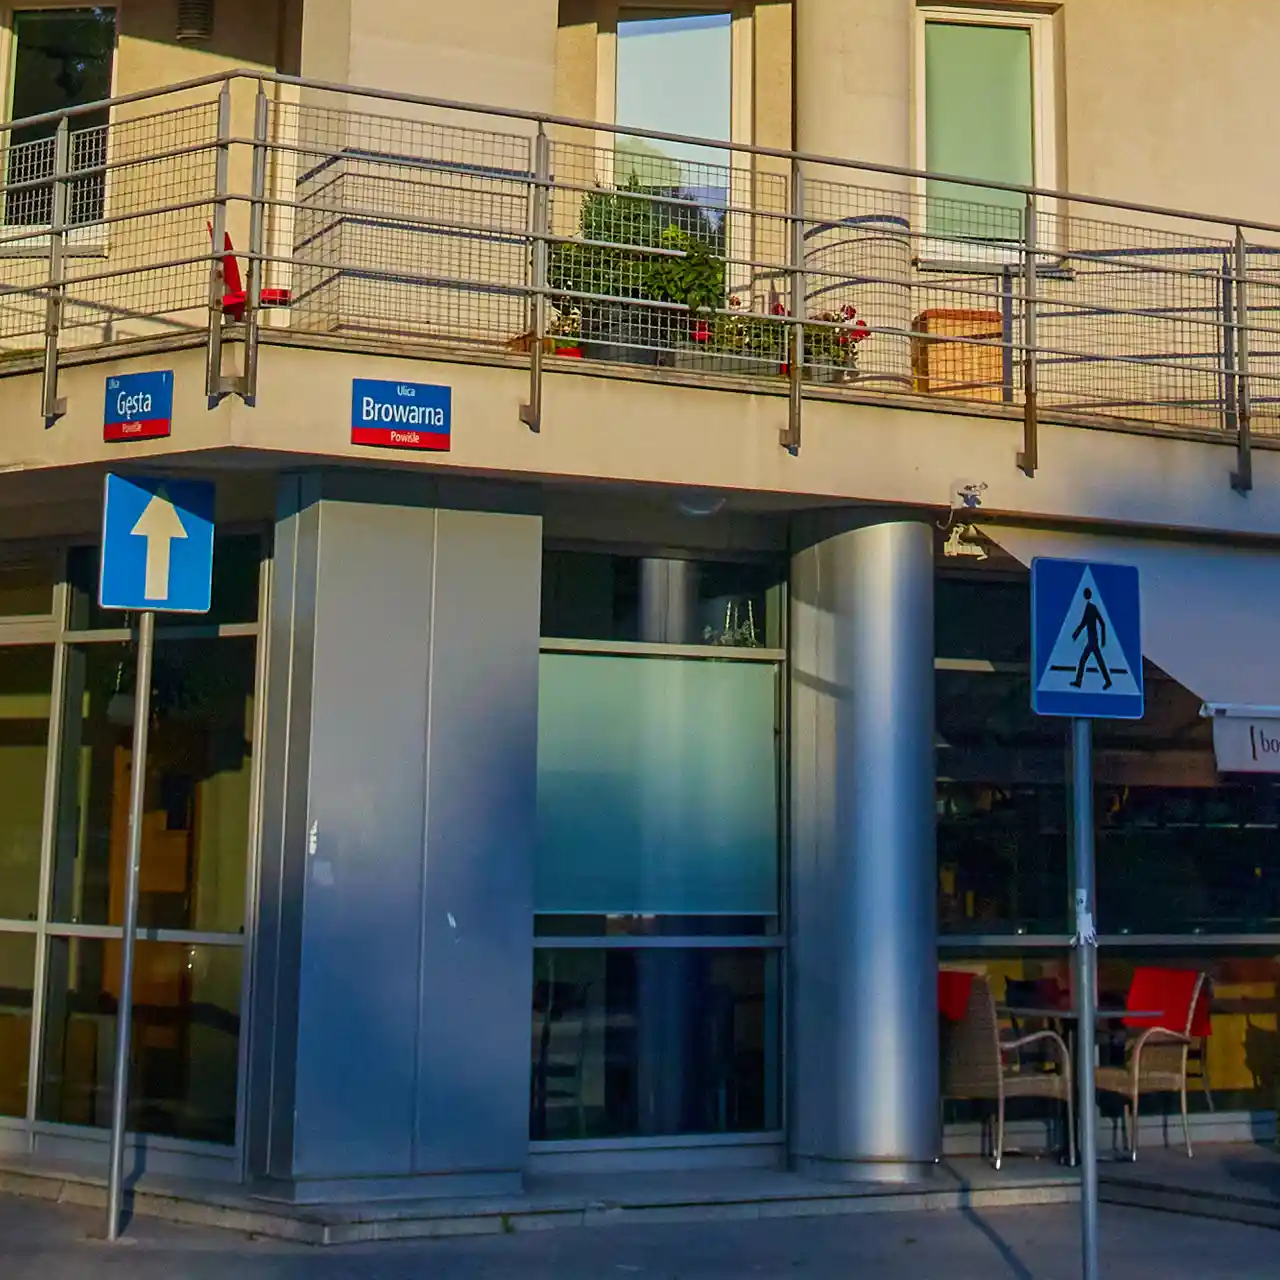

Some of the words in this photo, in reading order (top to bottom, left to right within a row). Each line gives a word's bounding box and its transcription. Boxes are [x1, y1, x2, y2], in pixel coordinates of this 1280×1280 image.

[397, 385, 416, 397] Ulica
[117, 391, 152, 420] Gęsta
[362, 396, 444, 426] Browarna
[390, 430, 420, 444] Powiśle
